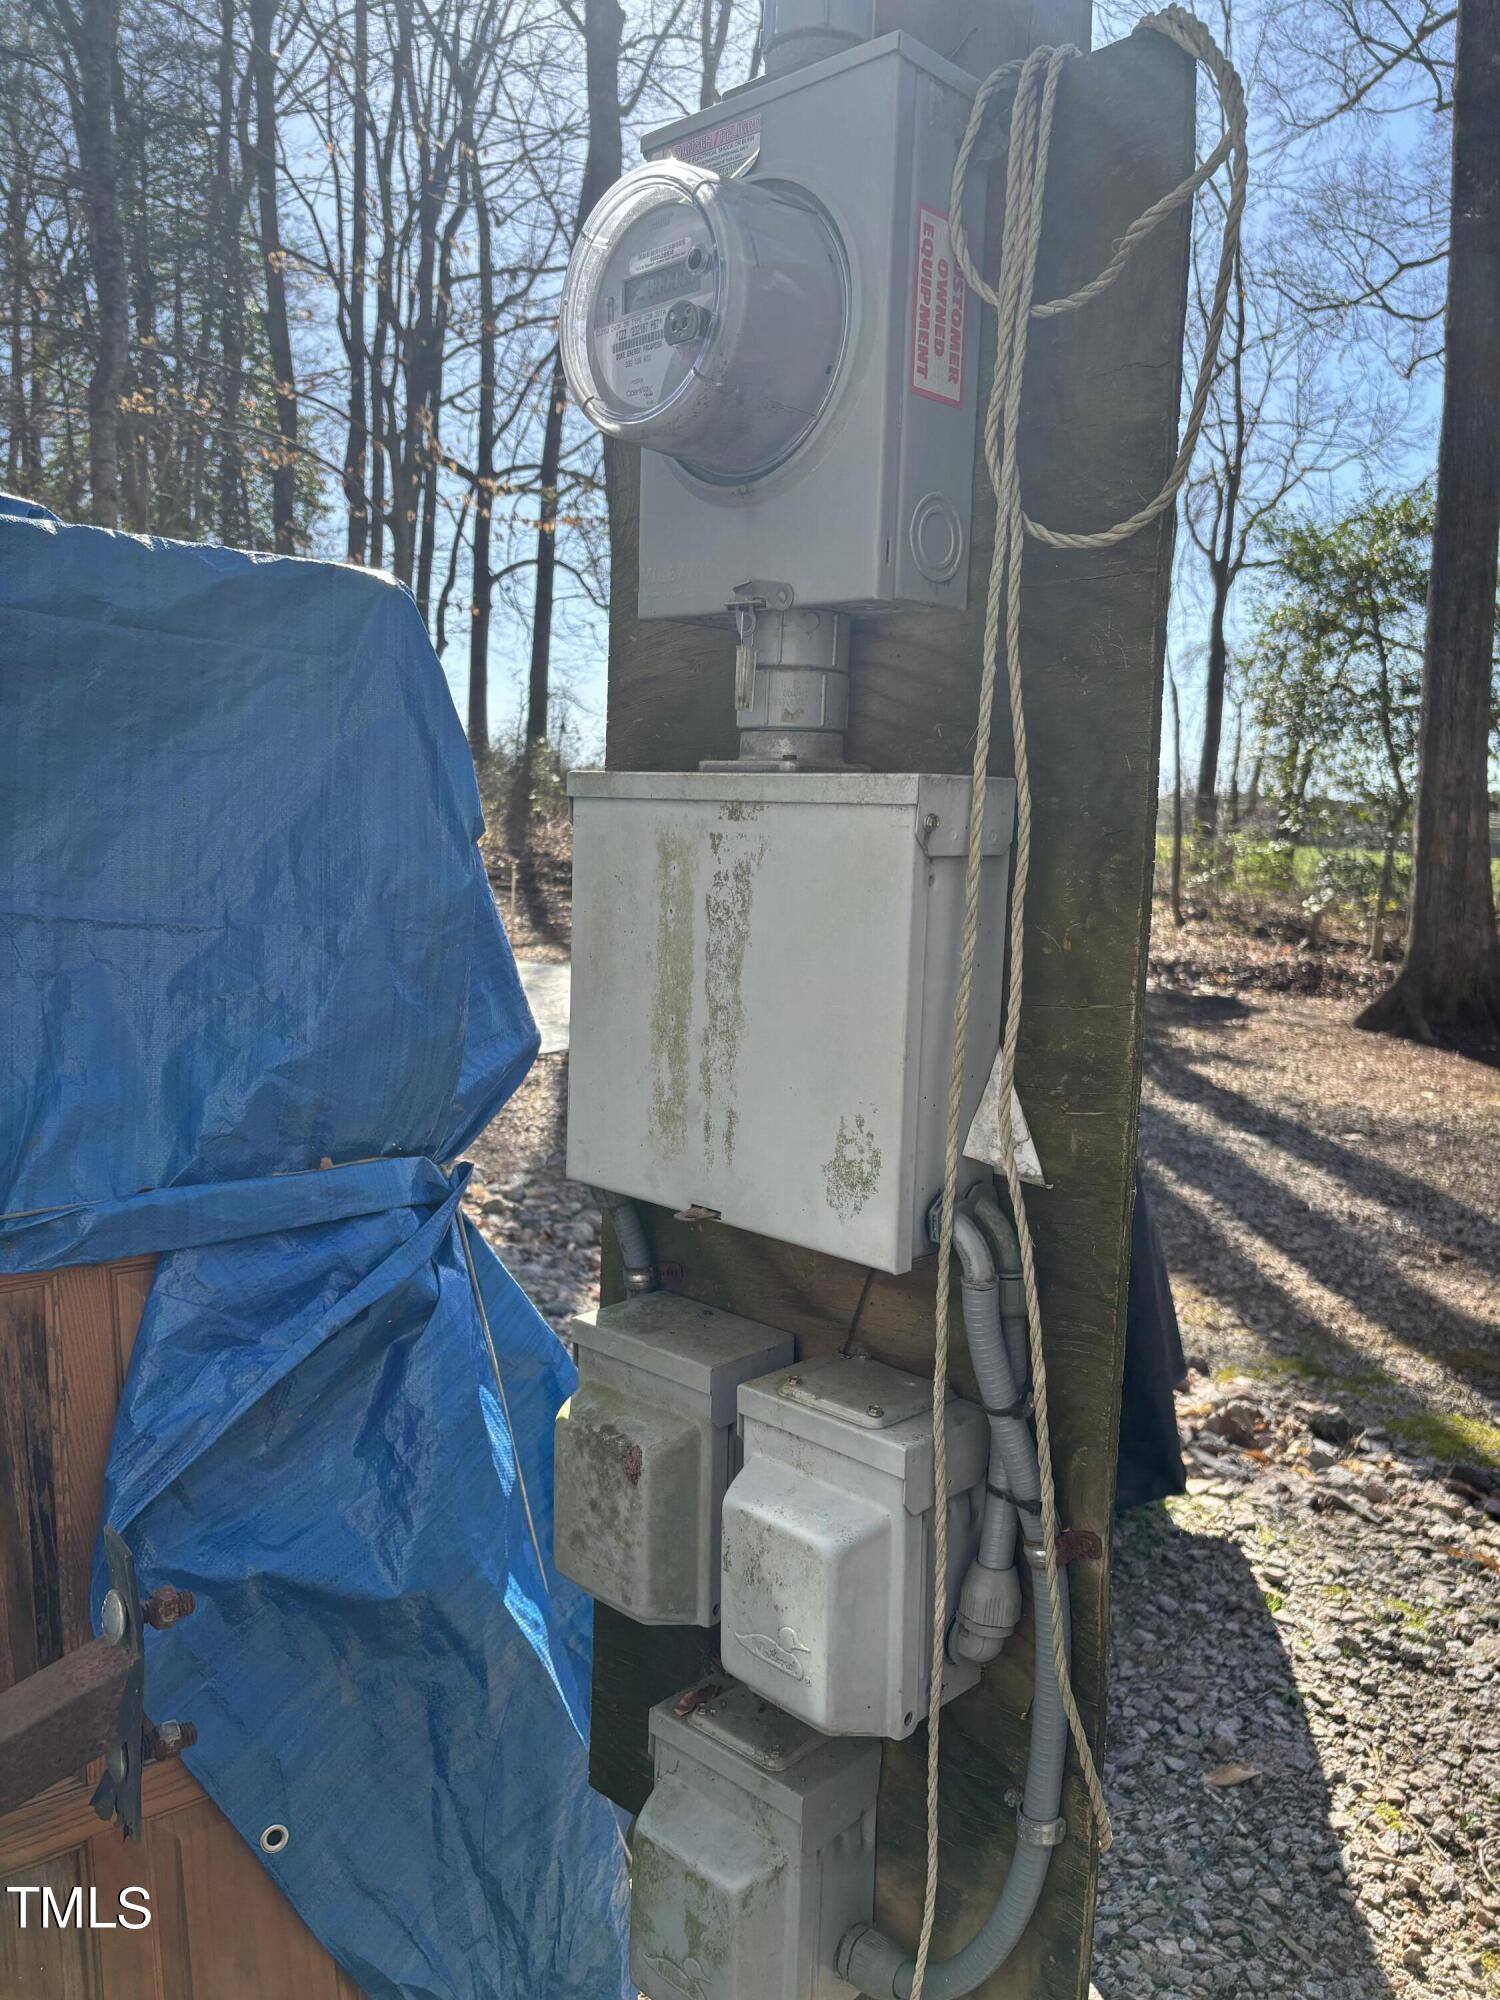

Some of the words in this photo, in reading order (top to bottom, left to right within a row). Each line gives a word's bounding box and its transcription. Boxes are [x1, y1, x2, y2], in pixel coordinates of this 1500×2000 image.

[917, 223, 934, 380] EQUIPMENT
[934, 259, 948, 357] OWNED
[948, 257, 964, 384] USTOMER
